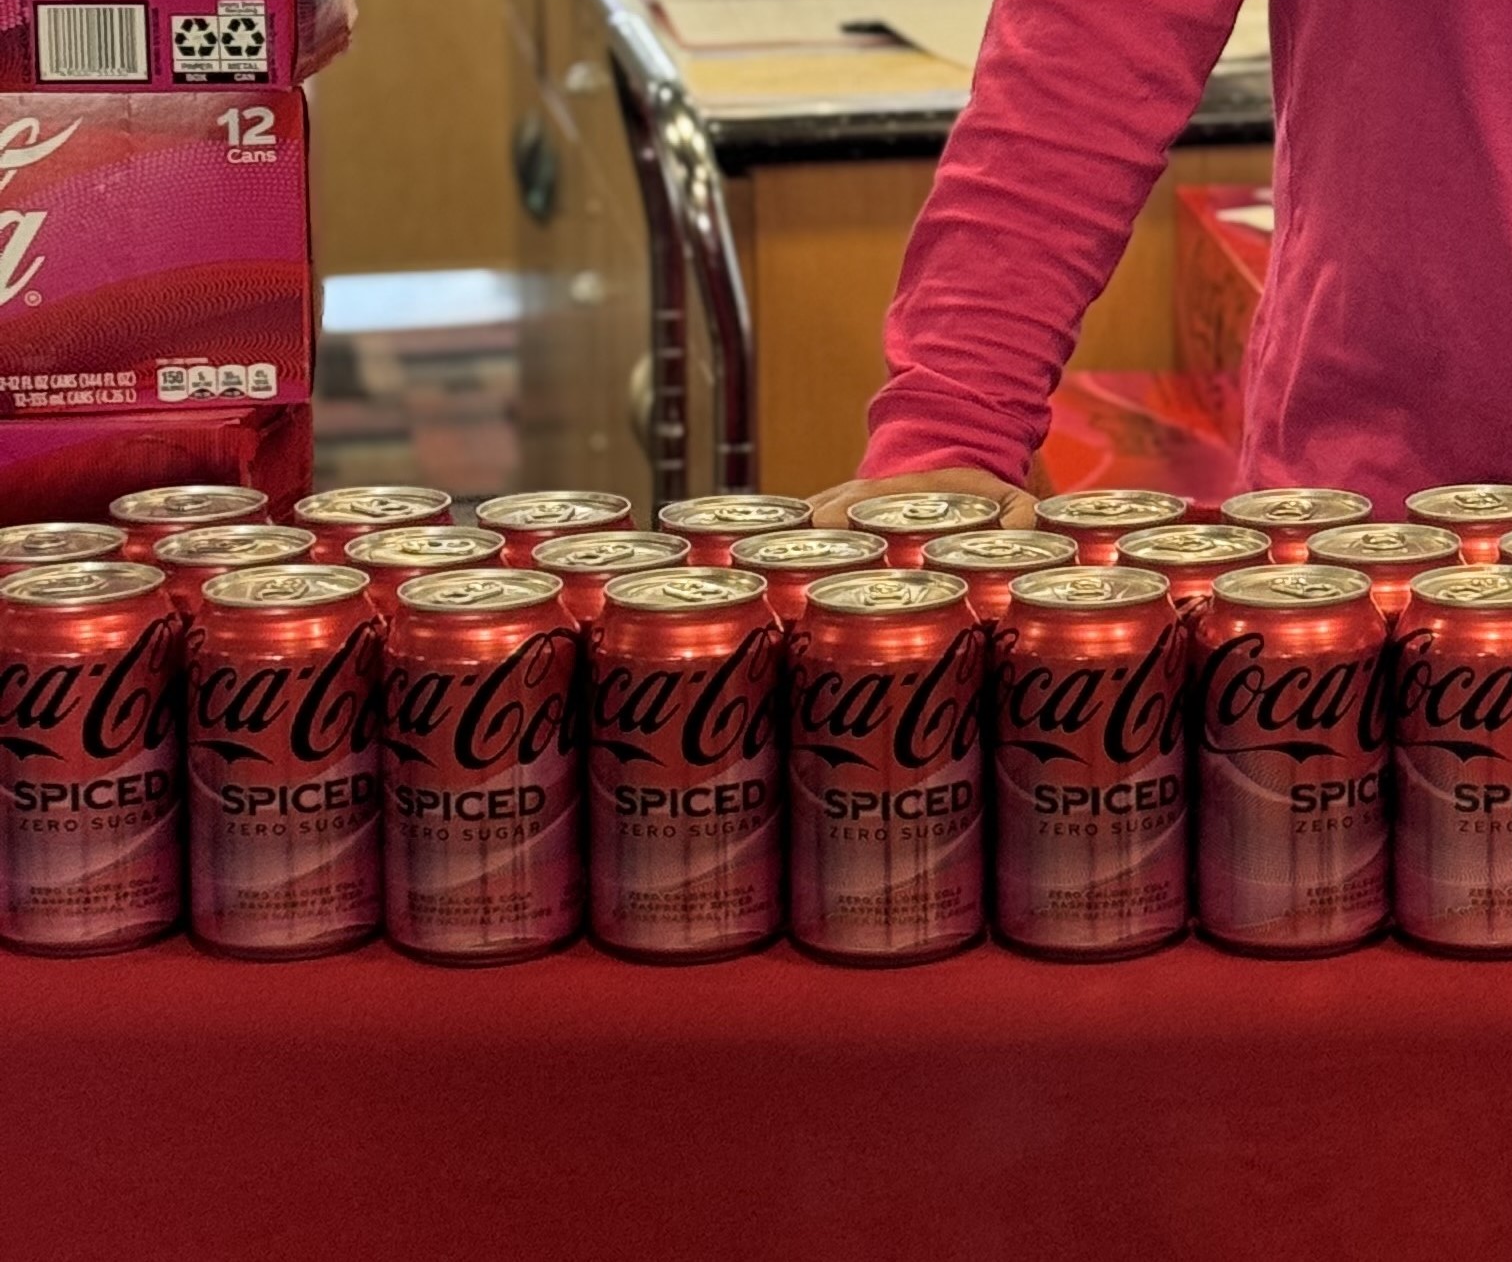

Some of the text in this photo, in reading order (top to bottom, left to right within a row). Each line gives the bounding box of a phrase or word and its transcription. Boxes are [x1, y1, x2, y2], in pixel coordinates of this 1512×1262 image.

[217, 106, 277, 146] 12
[228, 149, 277, 163] Cans
[162, 370, 184, 384] 150
[14, 769, 170, 814] SPICED
[221, 772, 379, 816] SPICED
[396, 783, 545, 823] SPICED
[615, 779, 766, 819] SPICED
[824, 779, 973, 821] SPICED
[1035, 774, 1179, 816] SPICED
[1291, 771, 1386, 814] SPIC
[20, 818, 79, 833] ZERO
[227, 821, 287, 836] ZERO
[398, 820, 541, 842] ZERO SUGAR
[618, 815, 762, 838] ZERO SUGAR
[829, 815, 970, 842] ZERO SUGAR
[1038, 811, 1177, 837] ZERO SUGAR
[1295, 816, 1355, 834] ZERO
